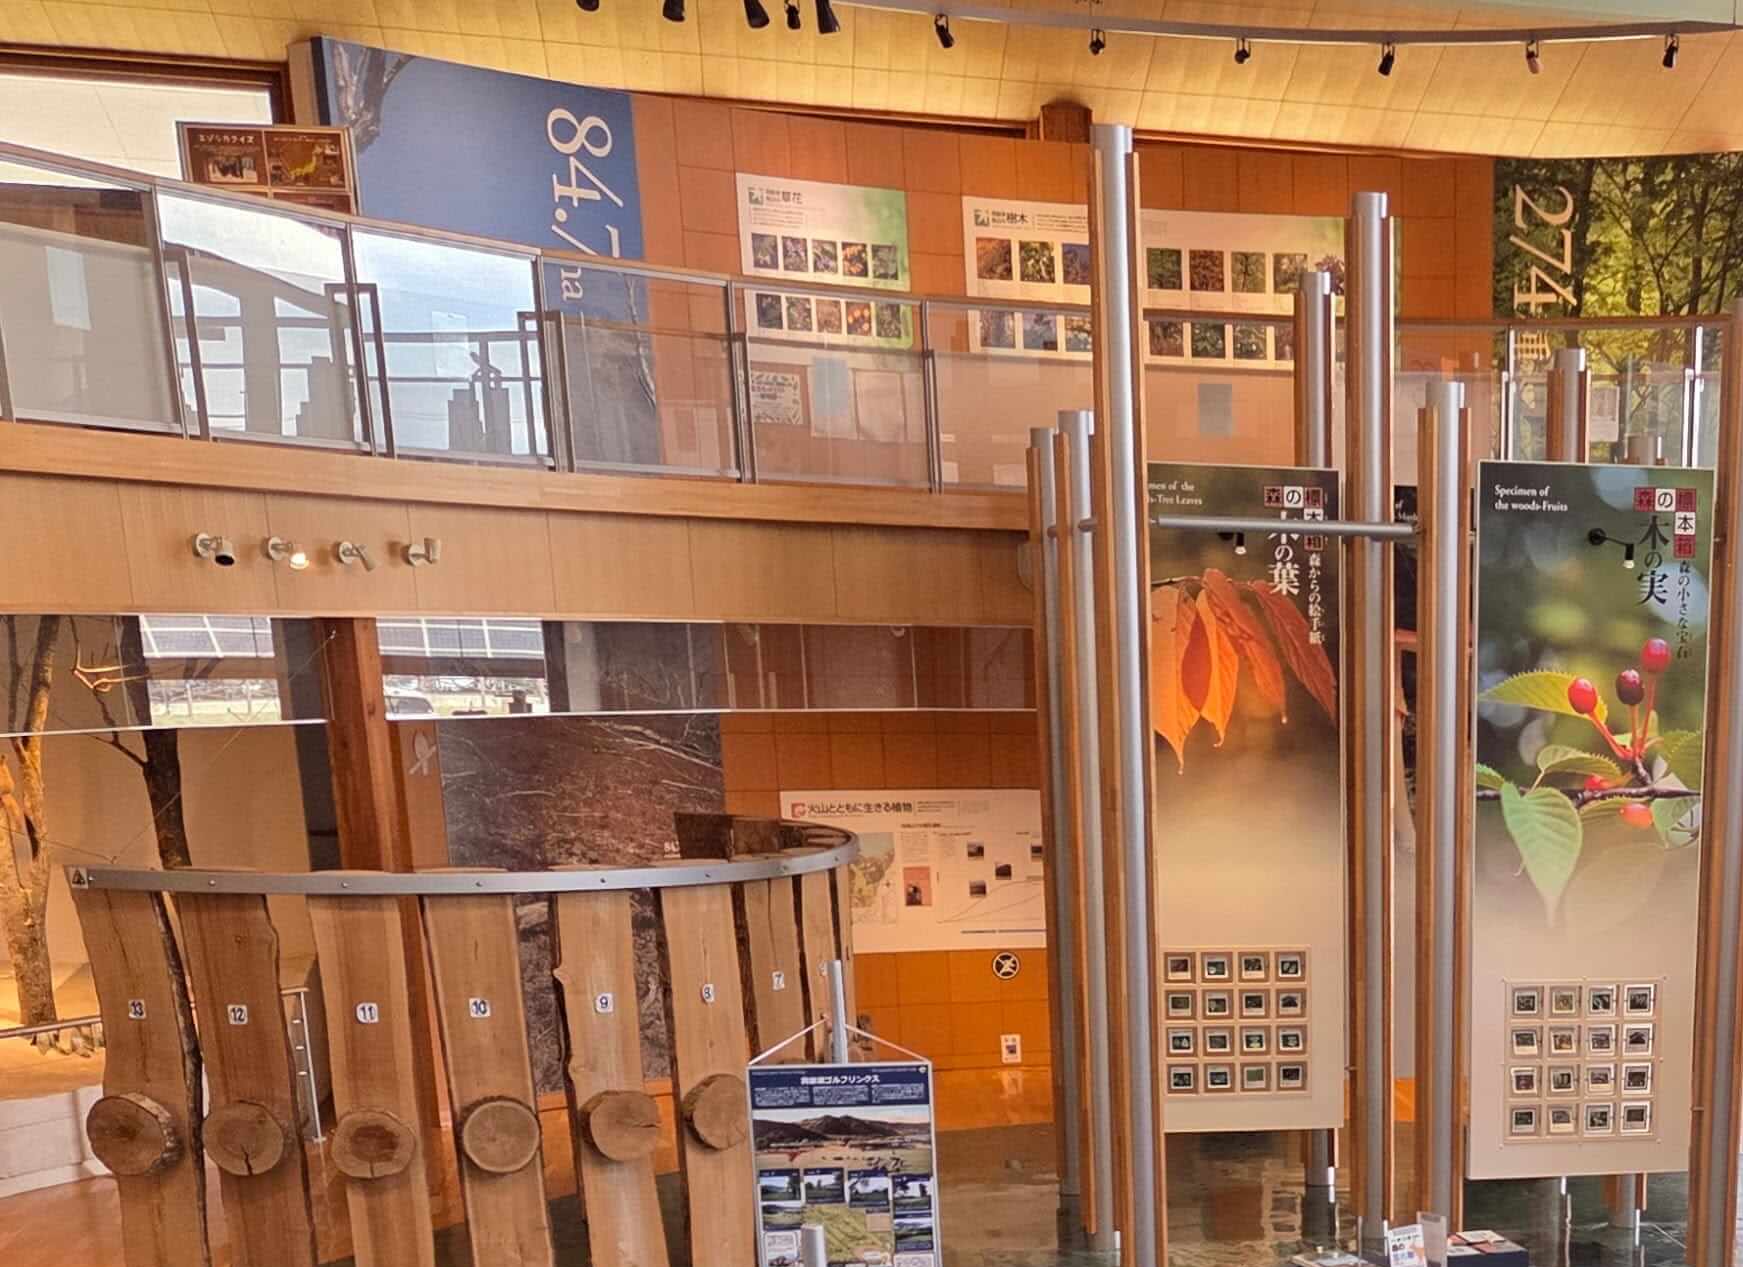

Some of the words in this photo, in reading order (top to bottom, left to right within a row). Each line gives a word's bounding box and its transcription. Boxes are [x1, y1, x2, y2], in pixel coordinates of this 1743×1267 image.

[546, 107, 625, 258] 84.7
[1510, 184, 1577, 312] 274
[1494, 485, 1537, 498] Specimen
[1539, 485, 1550, 497] of
[1494, 500, 1509, 511] the
[1637, 515, 1669, 605] 木の実
[808, 801, 913, 815] 火山とともに生きる植物
